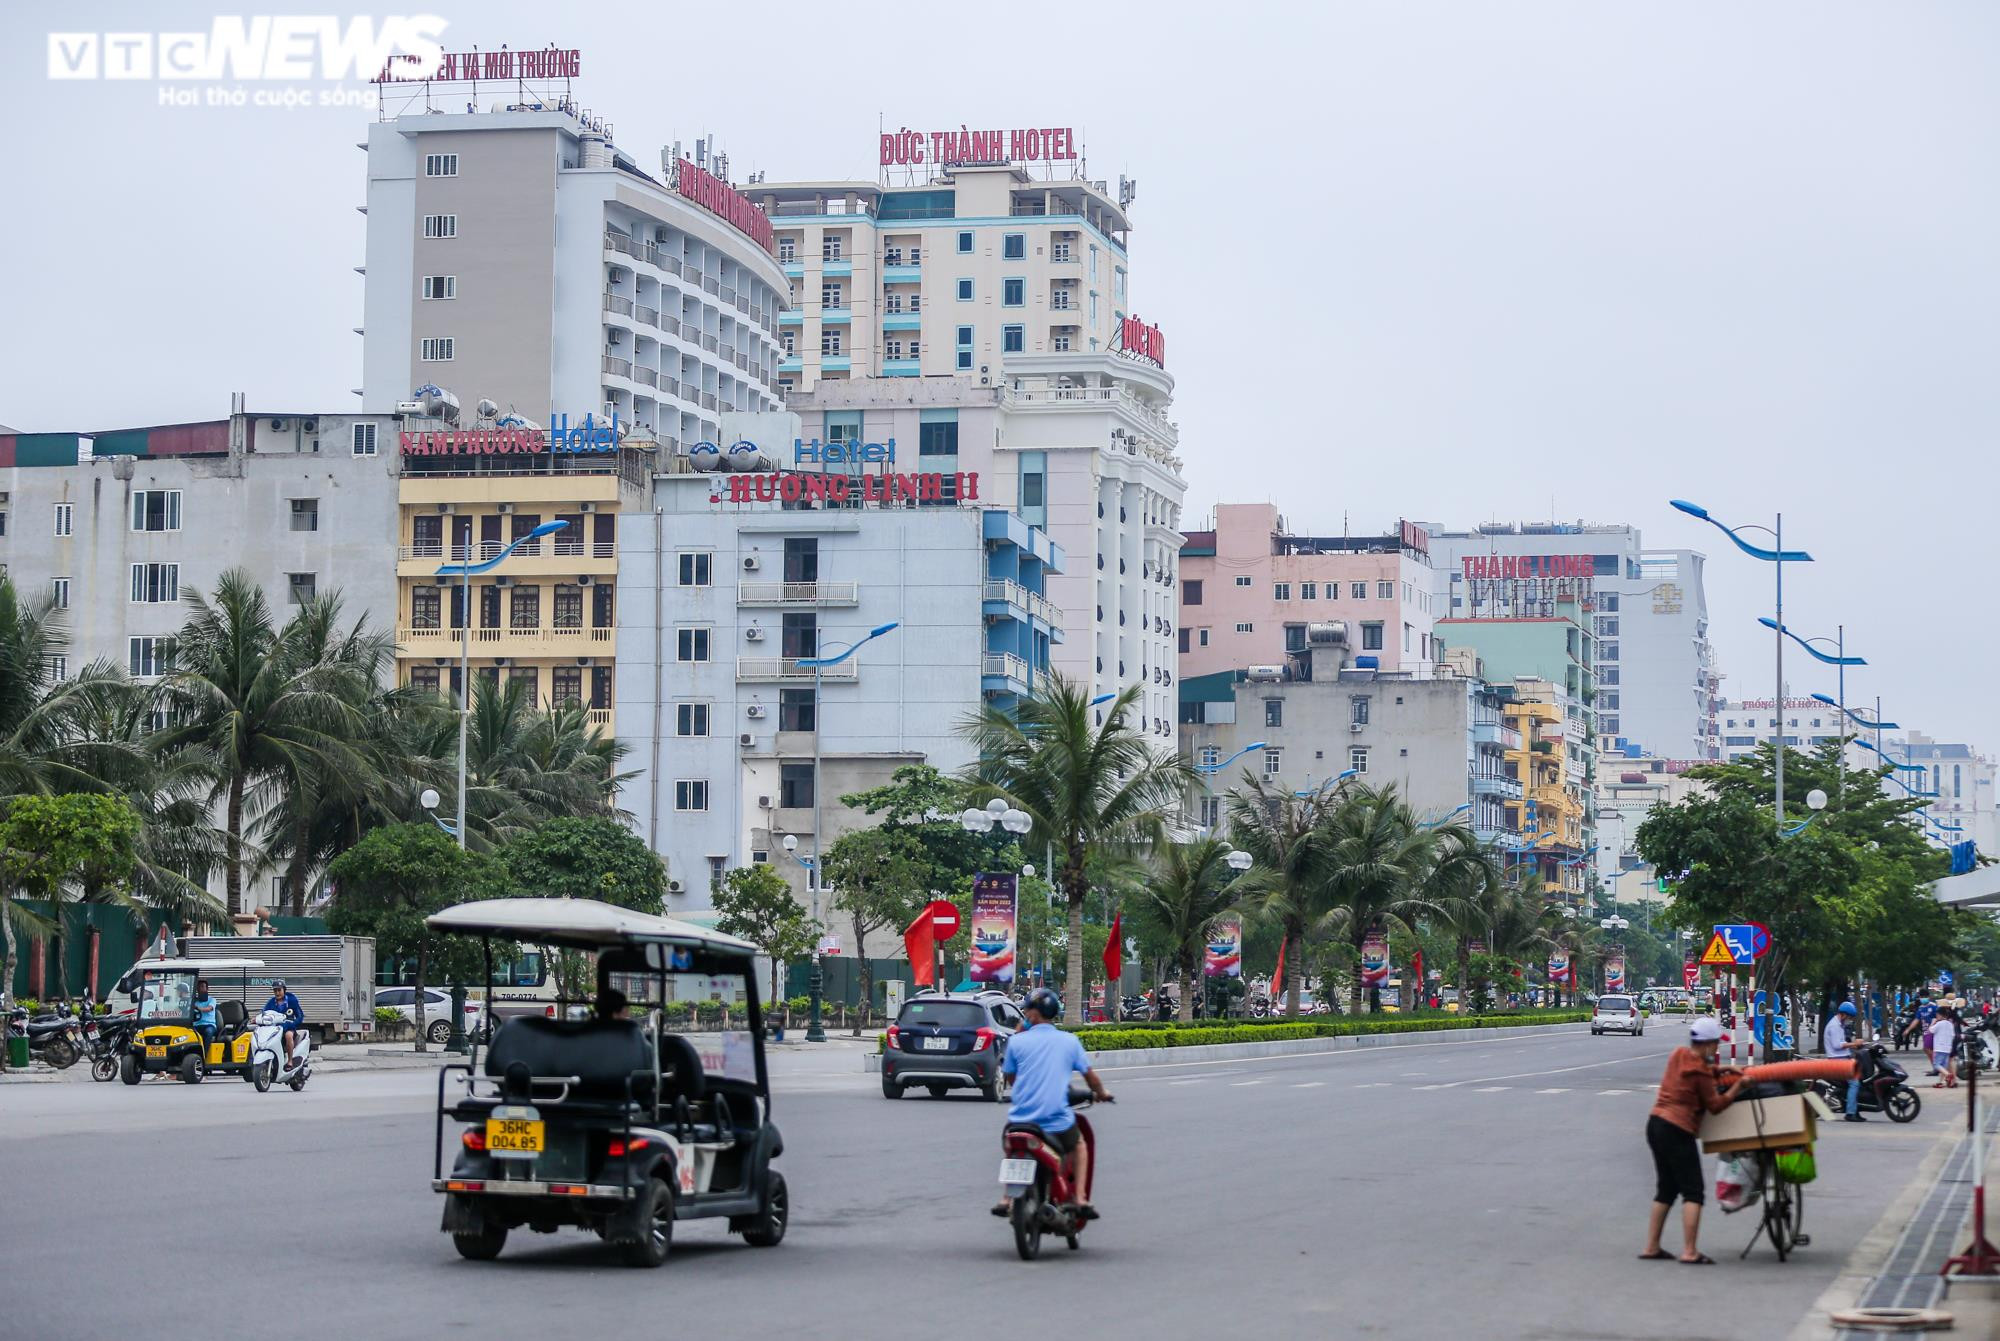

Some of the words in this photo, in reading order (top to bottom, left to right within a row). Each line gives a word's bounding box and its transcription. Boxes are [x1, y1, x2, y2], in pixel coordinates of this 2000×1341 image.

[463, 44, 480, 80] VÀ
[485, 43, 513, 79] MÔI
[518, 42, 580, 78] TRƯỜNG
[880, 127, 924, 165] ĐỨC
[931, 124, 1003, 163] THÀNH
[1011, 127, 1078, 161] HOTEL
[1122, 313, 1146, 355] ĐỨC
[400, 431, 449, 456] NAM
[452, 428, 546, 456] PHƯƠNG
[551, 411, 619, 454] Hotel
[794, 438, 896, 464] Hotel
[863, 473, 943, 501] LINH
[955, 472, 979, 500] II
[1461, 550, 1533, 579] THĂNG
[1538, 555, 1595, 578] LONG
[492, 1135, 537, 1149] 004.85
[500, 1121, 531, 1135] 36HC
